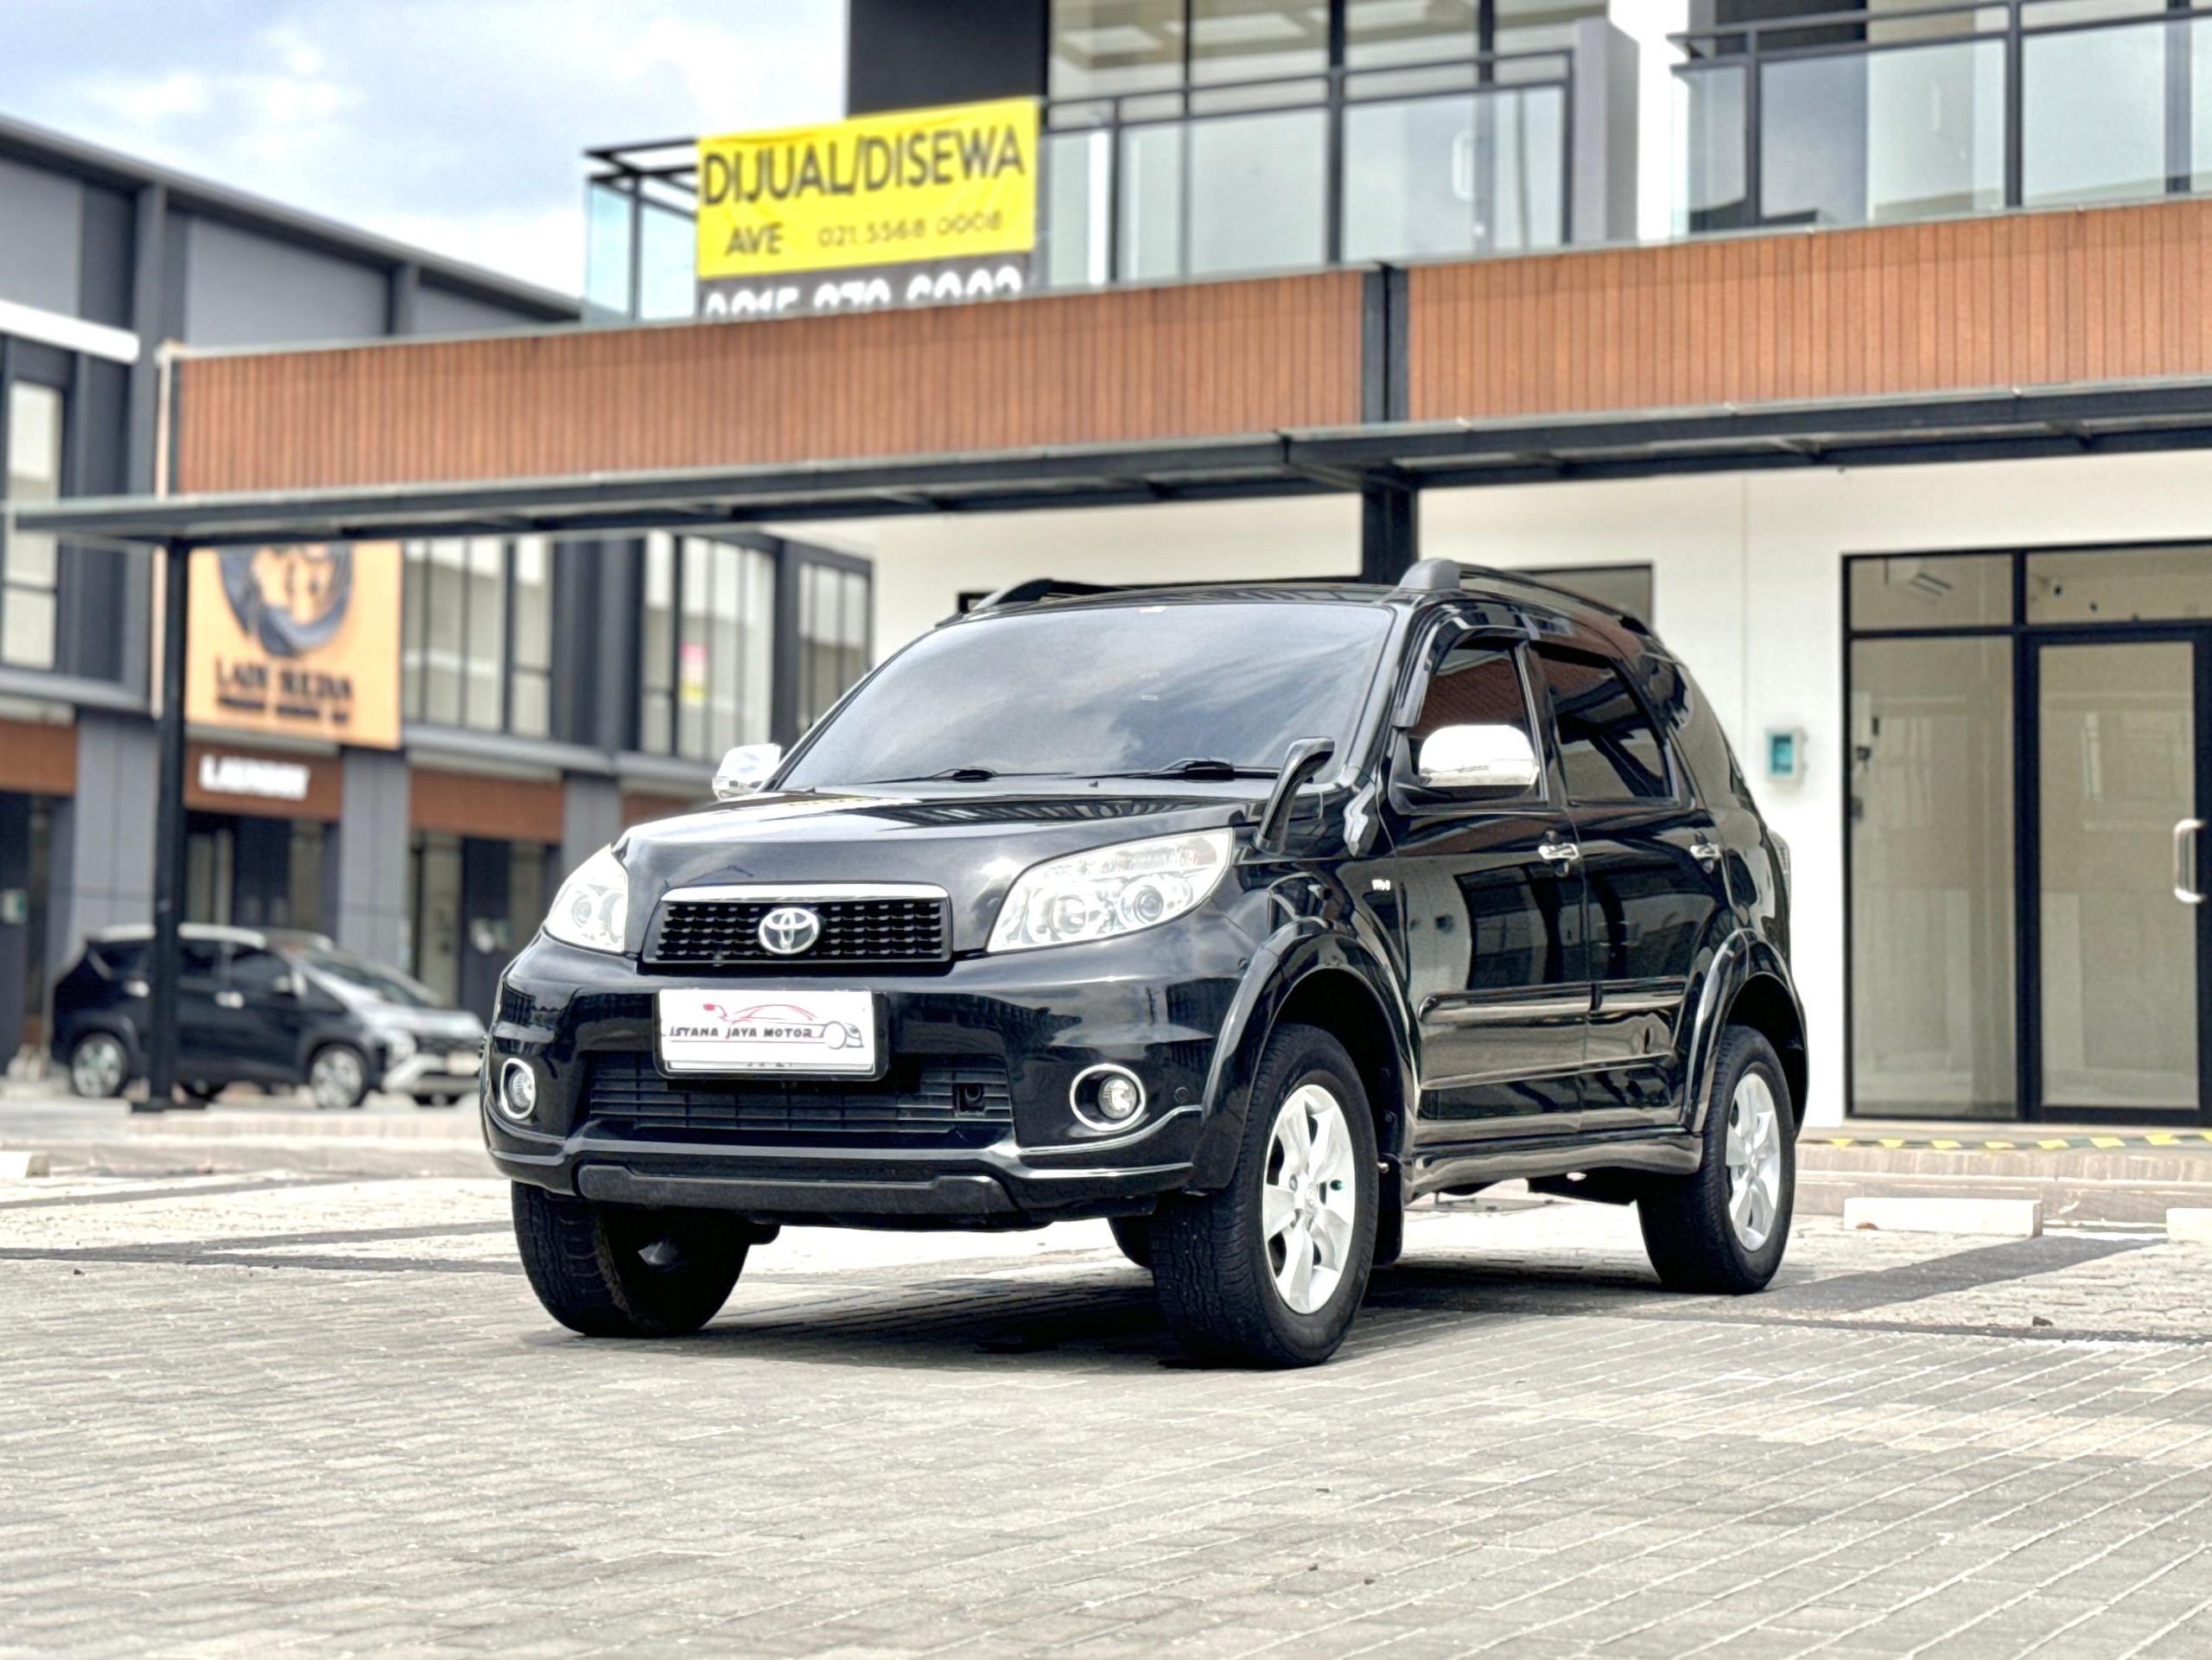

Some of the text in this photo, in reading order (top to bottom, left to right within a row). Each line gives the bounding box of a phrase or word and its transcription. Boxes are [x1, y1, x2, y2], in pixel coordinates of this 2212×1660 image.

[702, 124, 1026, 207] DIJUAL/DISEWA
[724, 220, 784, 258] AVE
[670, 1025, 813, 1040] ISTANA JAYA MOTOR
